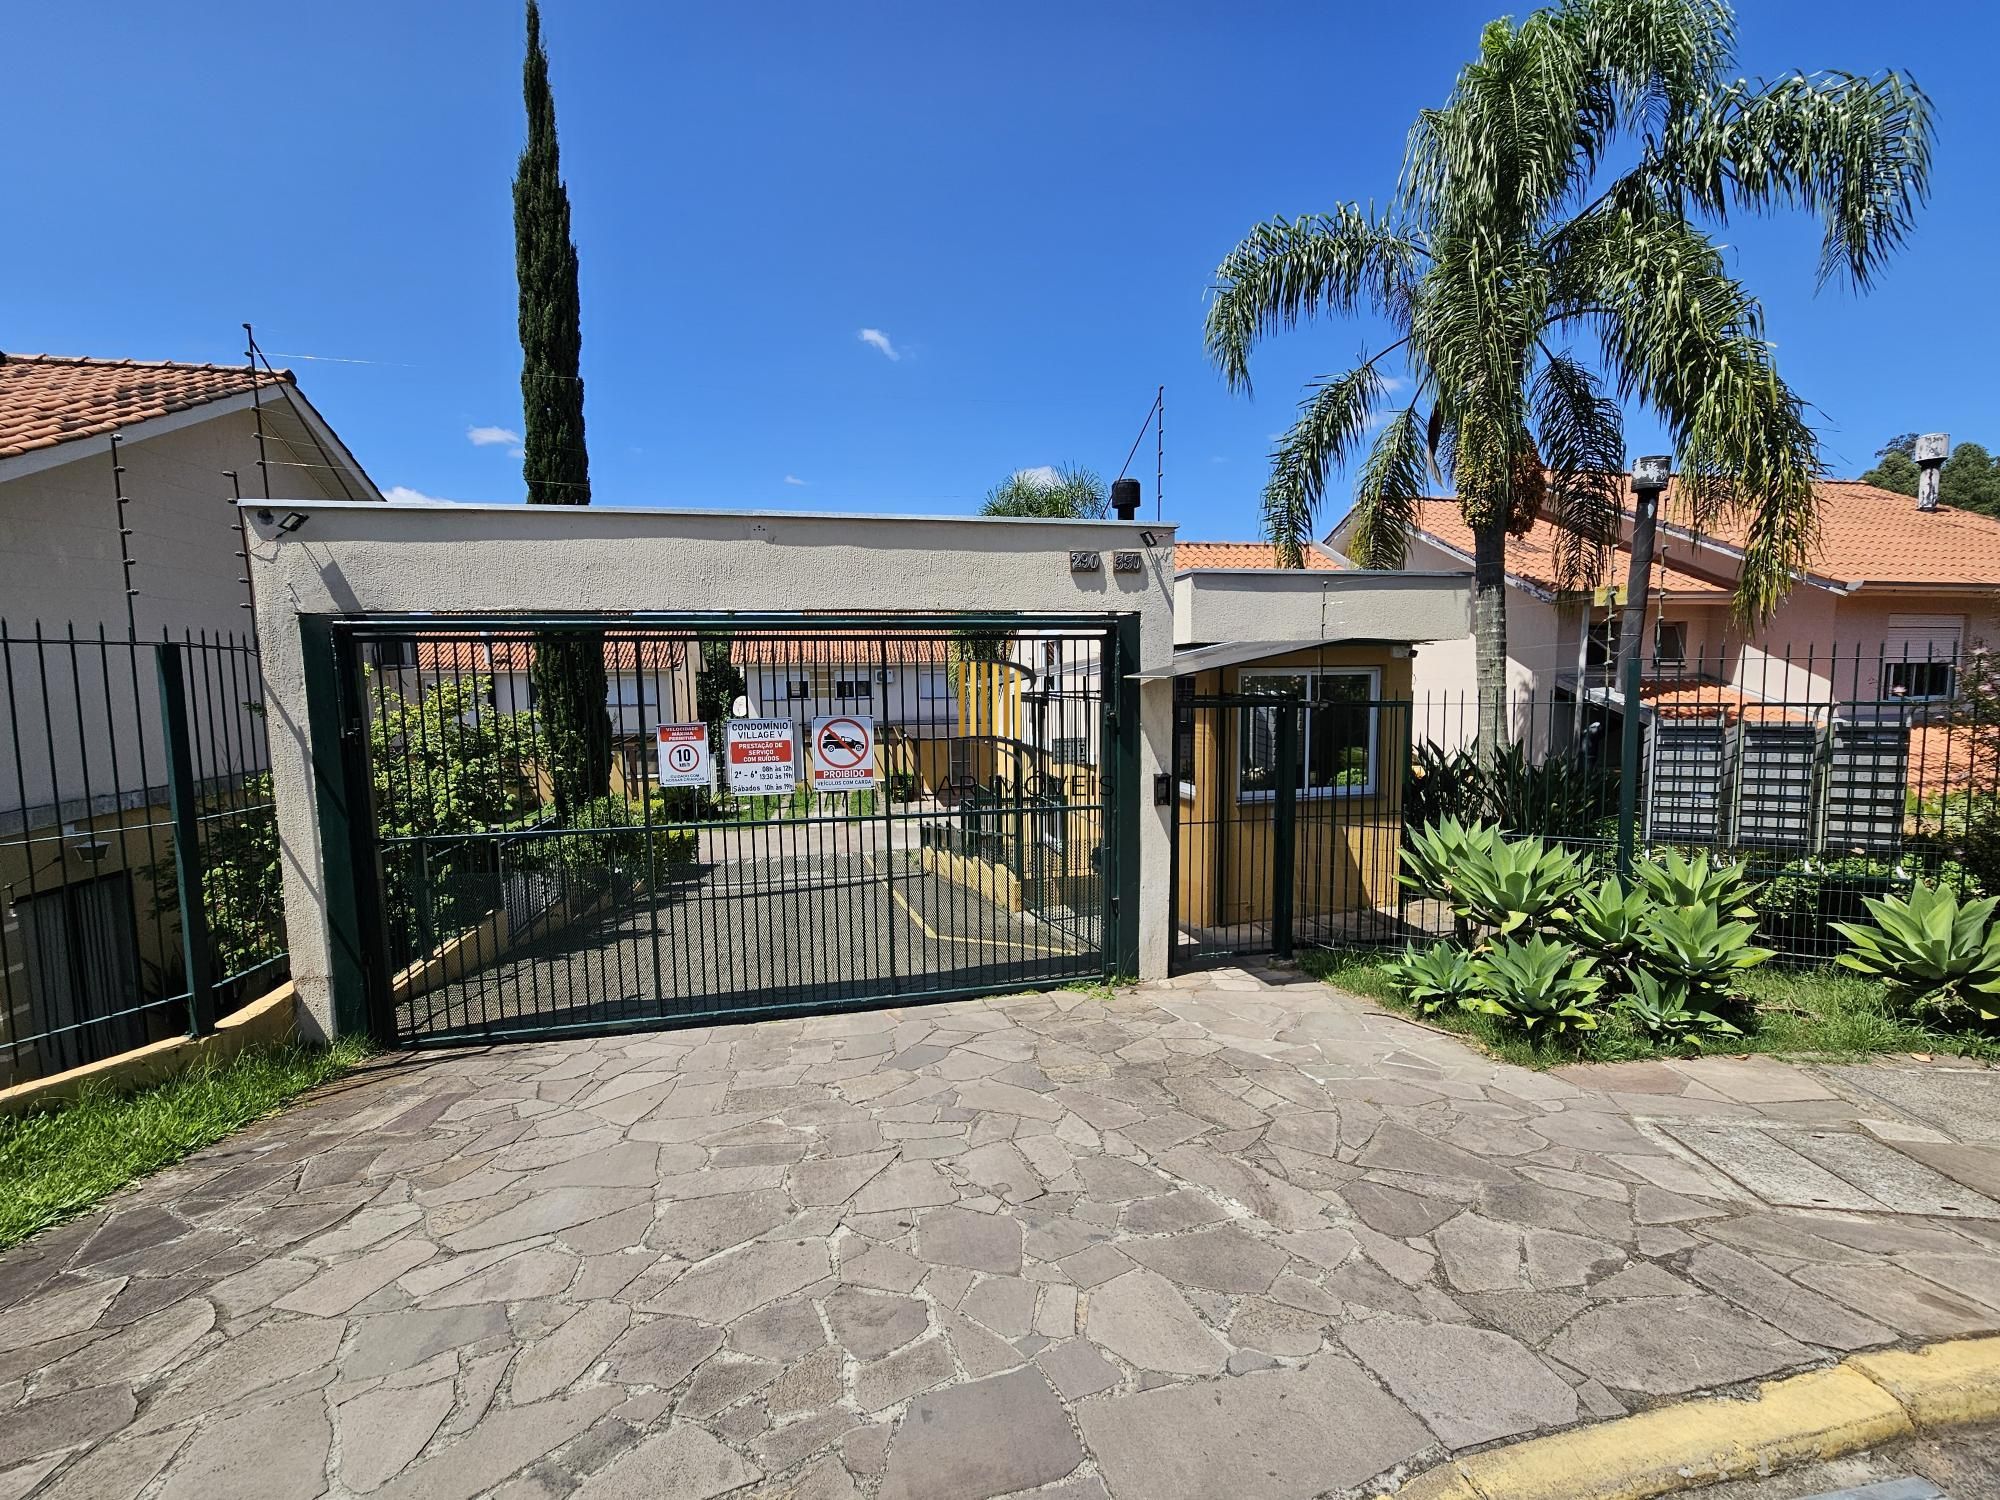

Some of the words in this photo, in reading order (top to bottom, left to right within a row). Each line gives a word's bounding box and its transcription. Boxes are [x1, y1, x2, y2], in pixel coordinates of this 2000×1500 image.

[1072, 553, 1098, 569] 290
[732, 721, 788, 731] CONDOMÍNIO
[738, 731, 775, 739] VILLAGE
[738, 742, 774, 750] PRESTAÇÃO
[676, 748, 691, 762] 10
[748, 749, 774, 757] SERVIÇO
[758, 754, 780, 762] RUÍDOS
[823, 769, 865, 779] PROIBIDO
[733, 784, 761, 793] Sábados
